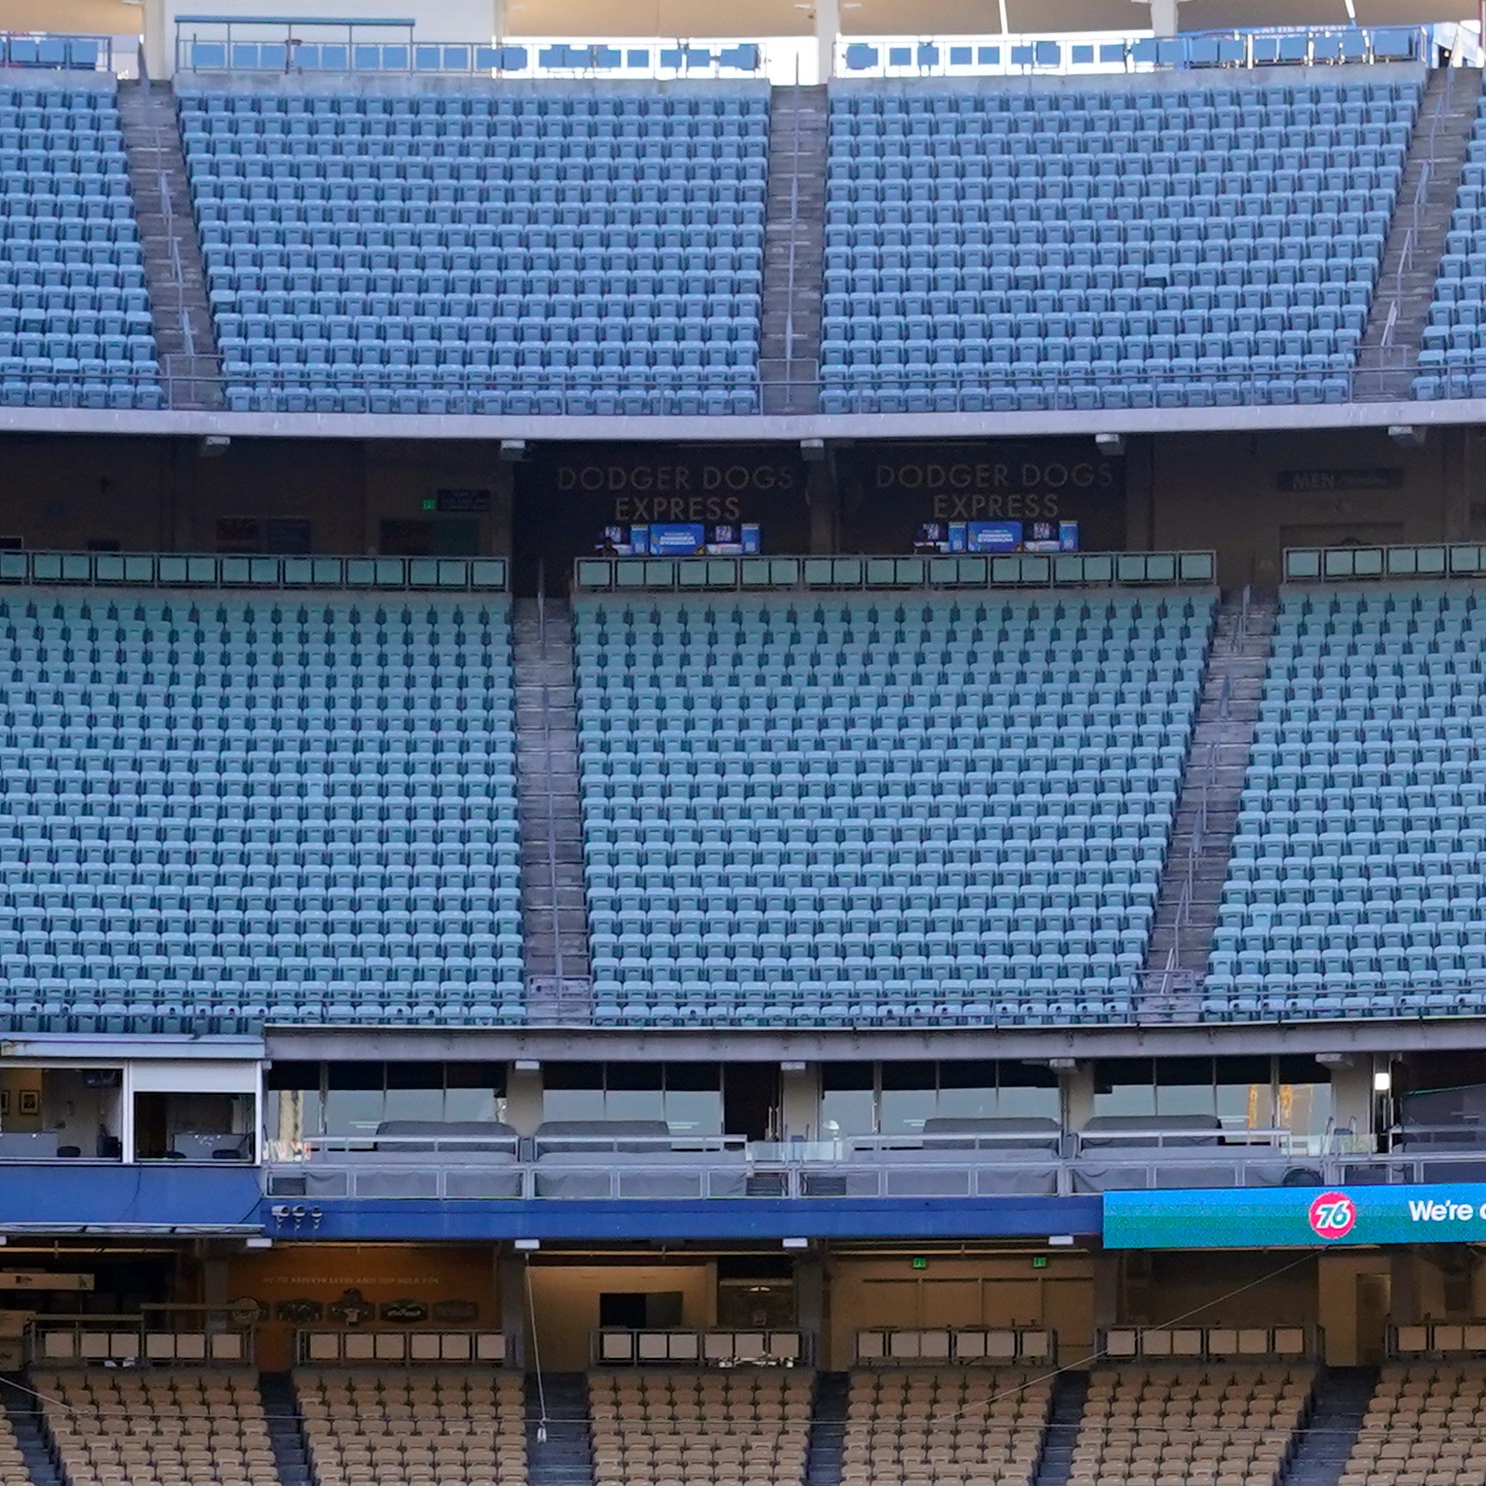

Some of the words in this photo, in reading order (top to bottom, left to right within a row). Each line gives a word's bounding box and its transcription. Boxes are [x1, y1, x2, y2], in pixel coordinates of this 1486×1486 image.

[557, 466, 690, 490] DODGER
[702, 466, 794, 490] DOGS
[876, 464, 1009, 488] DODGER
[1023, 463, 1114, 488] DOGS
[615, 497, 740, 521] EXPRESS
[932, 494, 1059, 519] EXPRESS
[1314, 1199, 1351, 1230] 76
[1409, 1200, 1473, 1222] We're
